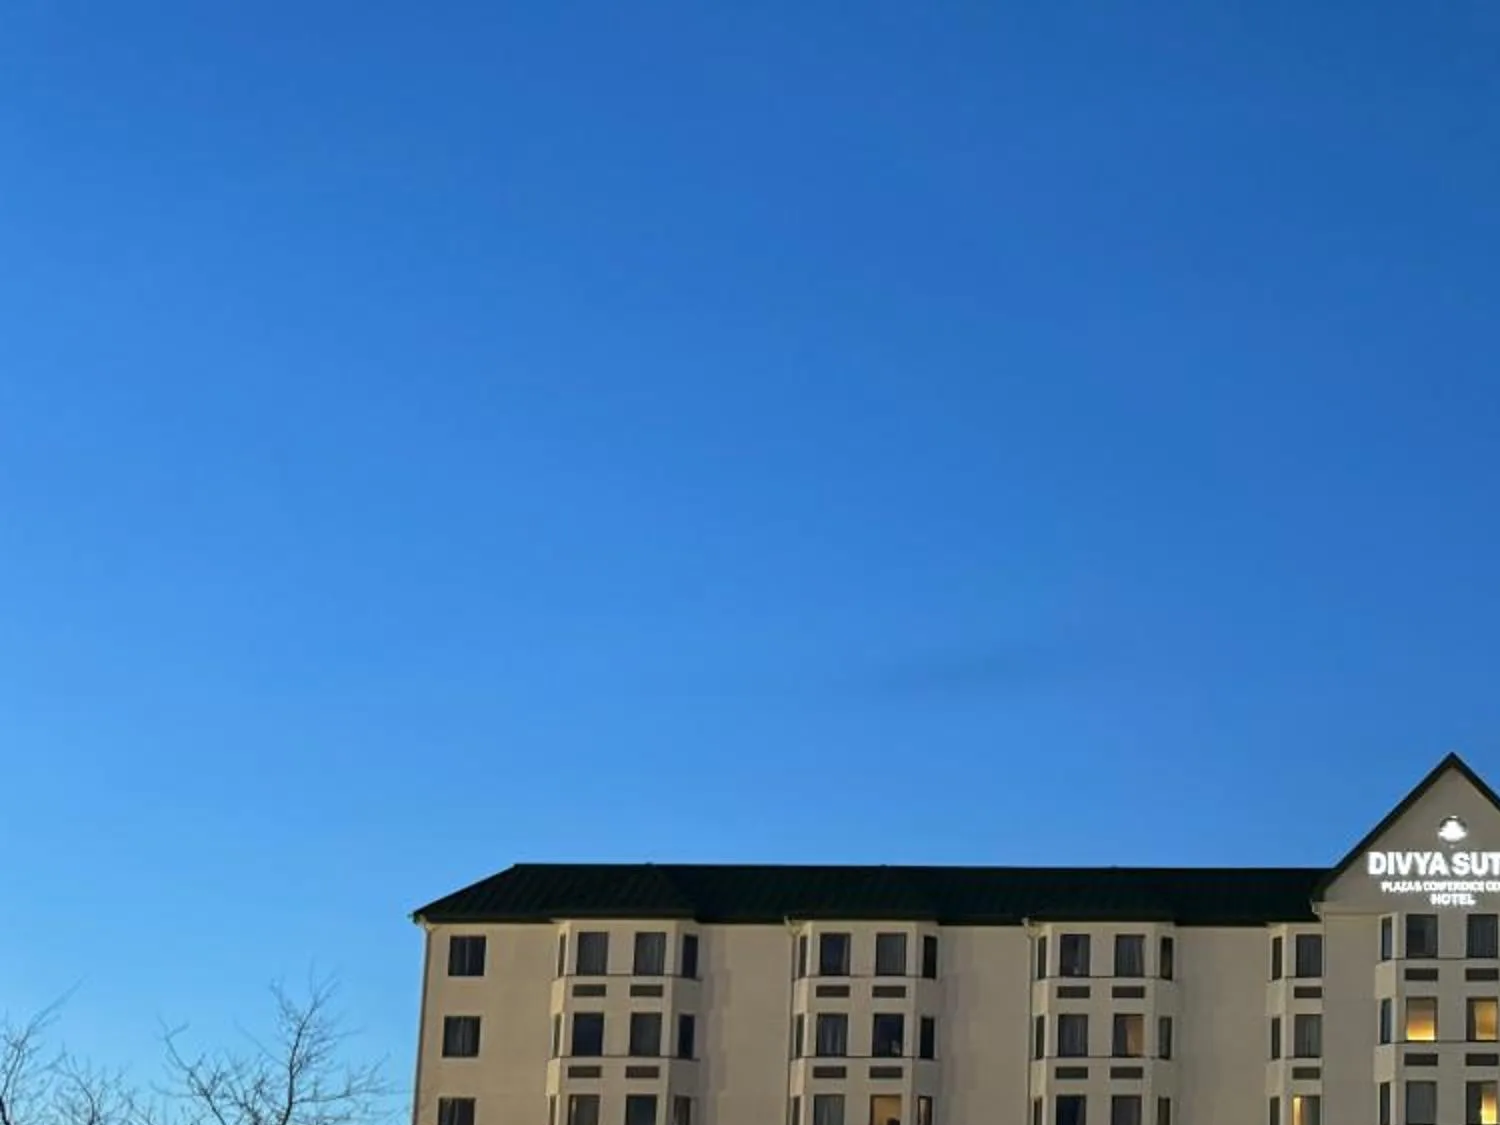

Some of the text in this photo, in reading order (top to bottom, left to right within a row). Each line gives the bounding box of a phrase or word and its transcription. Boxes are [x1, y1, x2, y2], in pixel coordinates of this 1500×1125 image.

[1367, 851, 1449, 876] DIVYA
[1380, 880, 1414, 893] PLAZA
[1423, 880, 1484, 893] CONFERENCE
[1430, 893, 1476, 906] HOTEL
